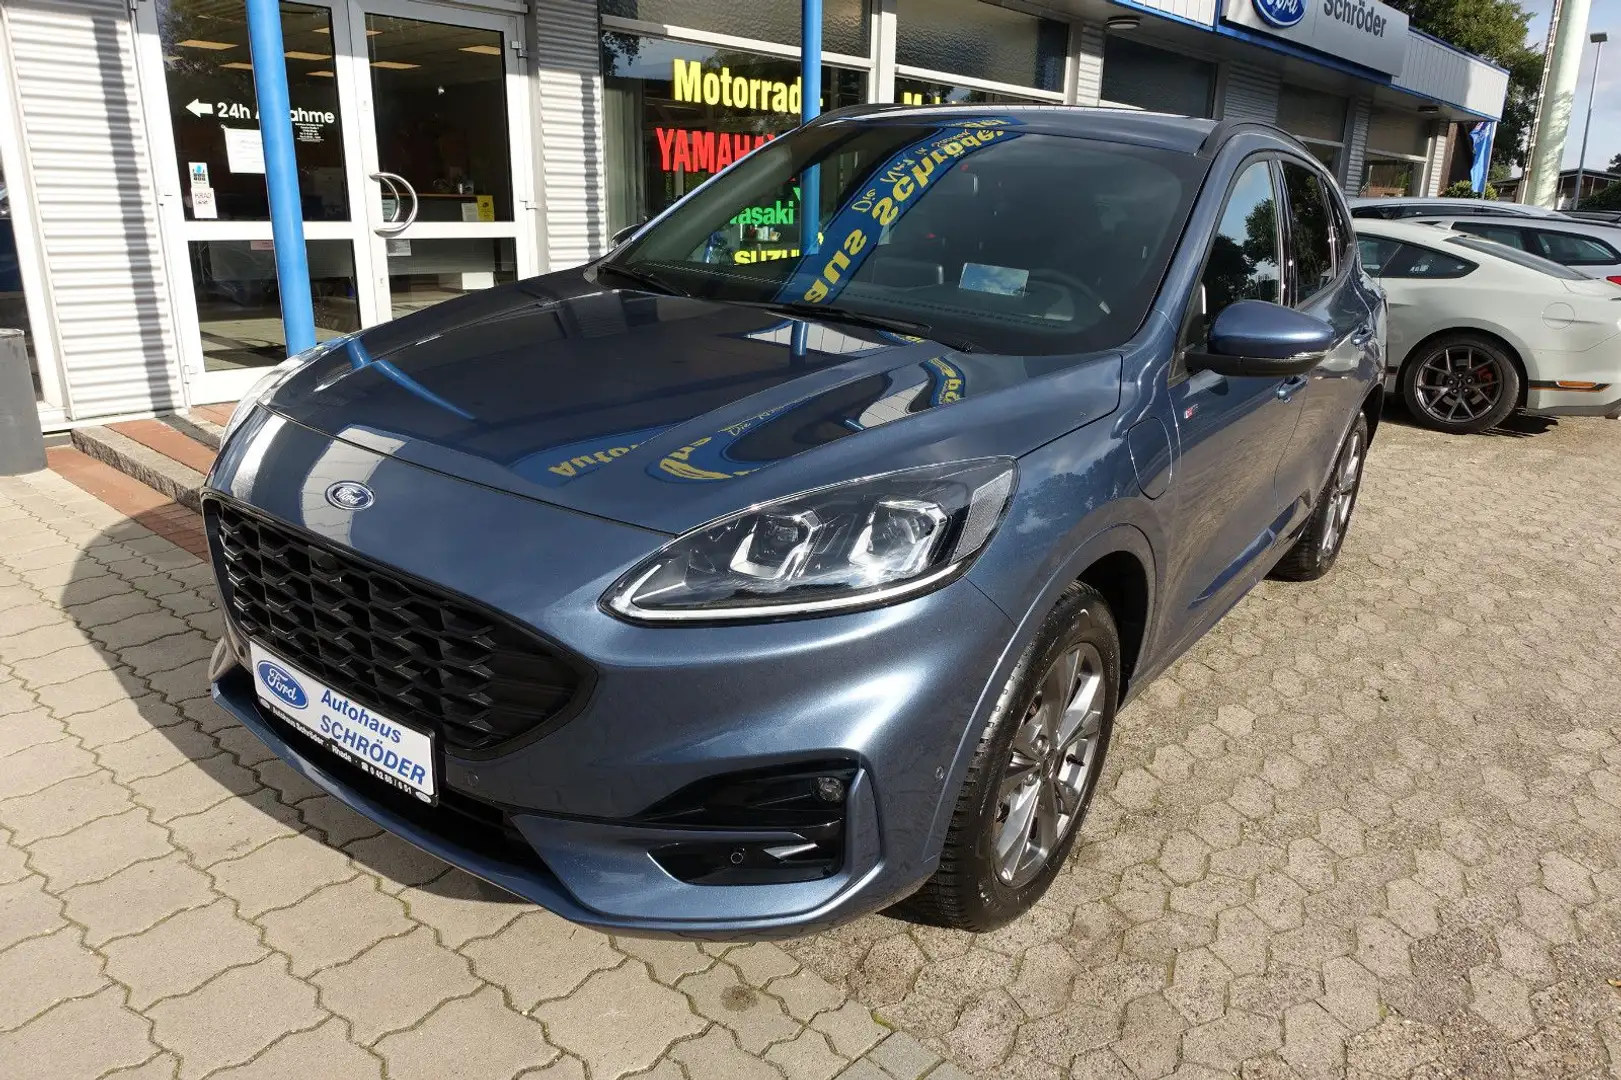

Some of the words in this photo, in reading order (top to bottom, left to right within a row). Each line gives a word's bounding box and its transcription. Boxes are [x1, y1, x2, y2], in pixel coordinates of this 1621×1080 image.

[1323, 0, 1387, 37] Schröder
[674, 58, 823, 114] Motorrad
[217, 102, 251, 119] 24h
[656, 127, 769, 174] YAMAH
[730, 201, 794, 225] asaki
[267, 667, 298, 701] Ford
[320, 689, 402, 743] Autohaus
[320, 714, 427, 786] SCHRÖDER
